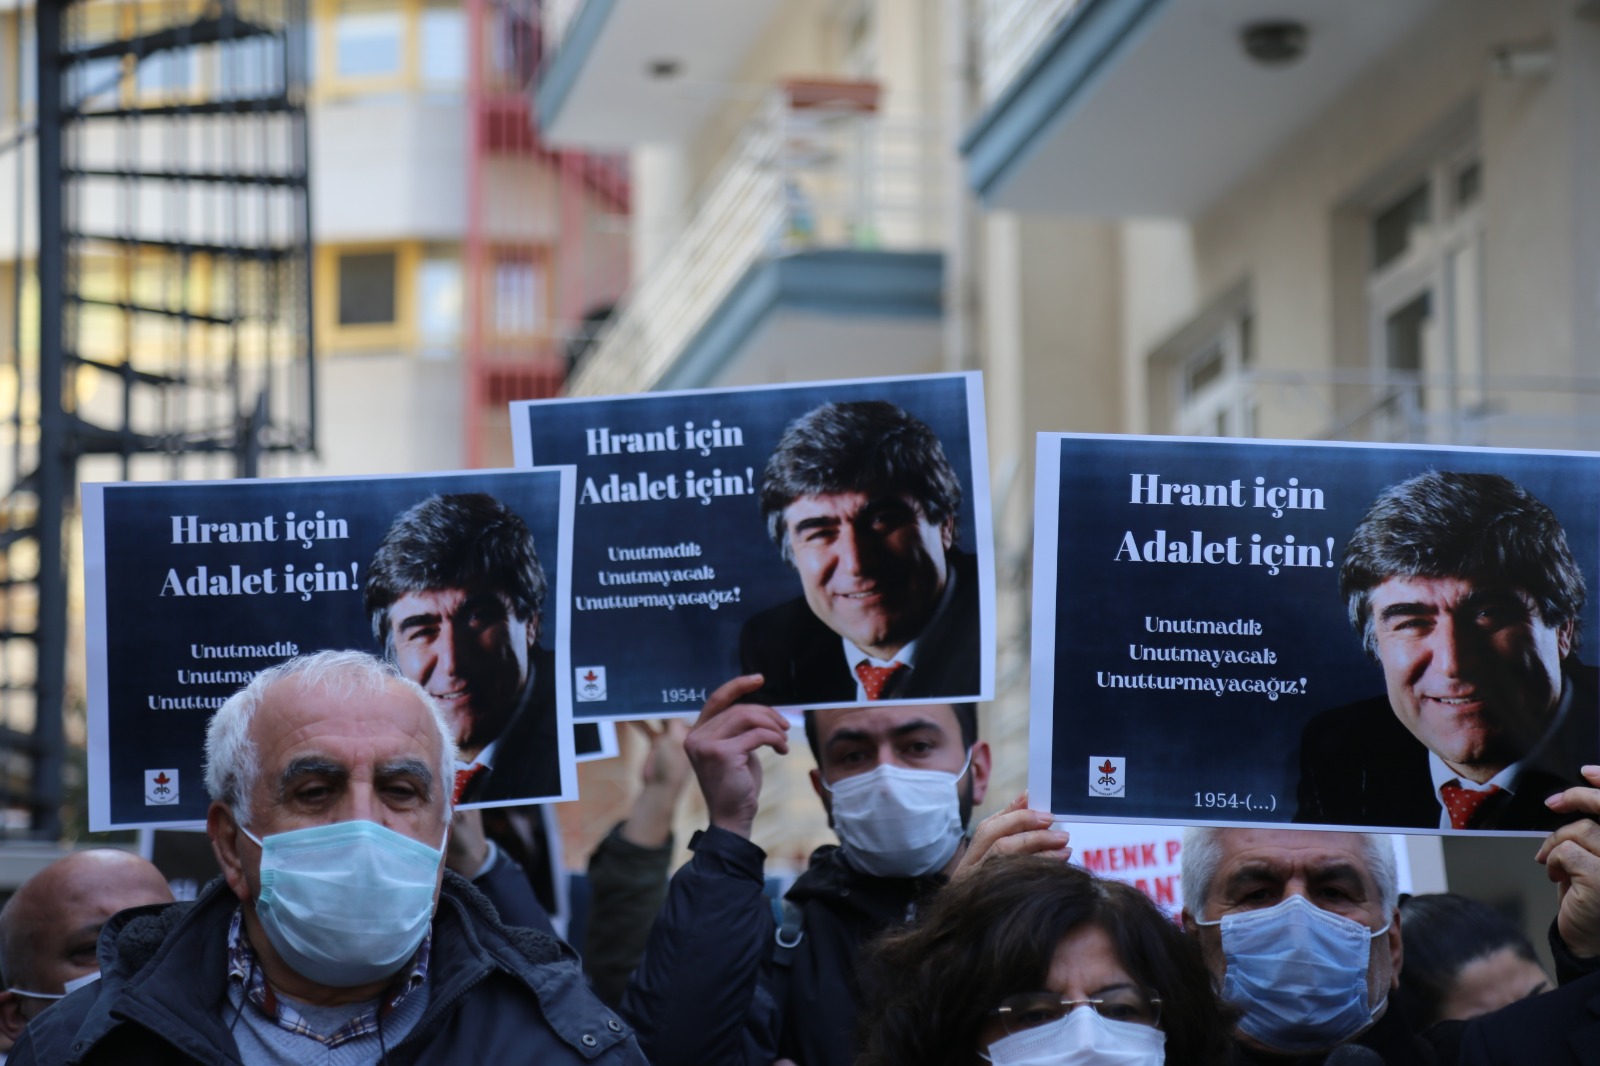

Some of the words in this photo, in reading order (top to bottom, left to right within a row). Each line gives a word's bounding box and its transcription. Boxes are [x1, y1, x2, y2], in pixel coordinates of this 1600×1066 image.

[586, 426, 679, 455] Hrant
[685, 419, 743, 456] için
[580, 472, 680, 504] Adalet
[686, 467, 754, 505] için!
[1129, 474, 1246, 507] Hrant
[1253, 476, 1325, 517] için
[171, 515, 278, 543] Hrant
[285, 510, 349, 549] için
[608, 542, 702, 561] Unutmadık
[1114, 530, 1242, 564] Adalet
[1250, 534, 1334, 575] için!
[160, 565, 277, 596] Adalet
[284, 562, 358, 601] için!
[598, 565, 715, 587] Unutmayacak
[575, 587, 741, 611] Unutturmayacağız!
[1146, 616, 1263, 636] Unutmadık
[191, 641, 299, 660] Unutmadık
[1129, 644, 1278, 668] Unutmayacak
[661, 688, 708, 703] 1954-(
[1096, 671, 1307, 701] Unutturmayacağız!
[1194, 792, 1277, 811] 1954-(...)
[1082, 843, 1157, 872] MENK
